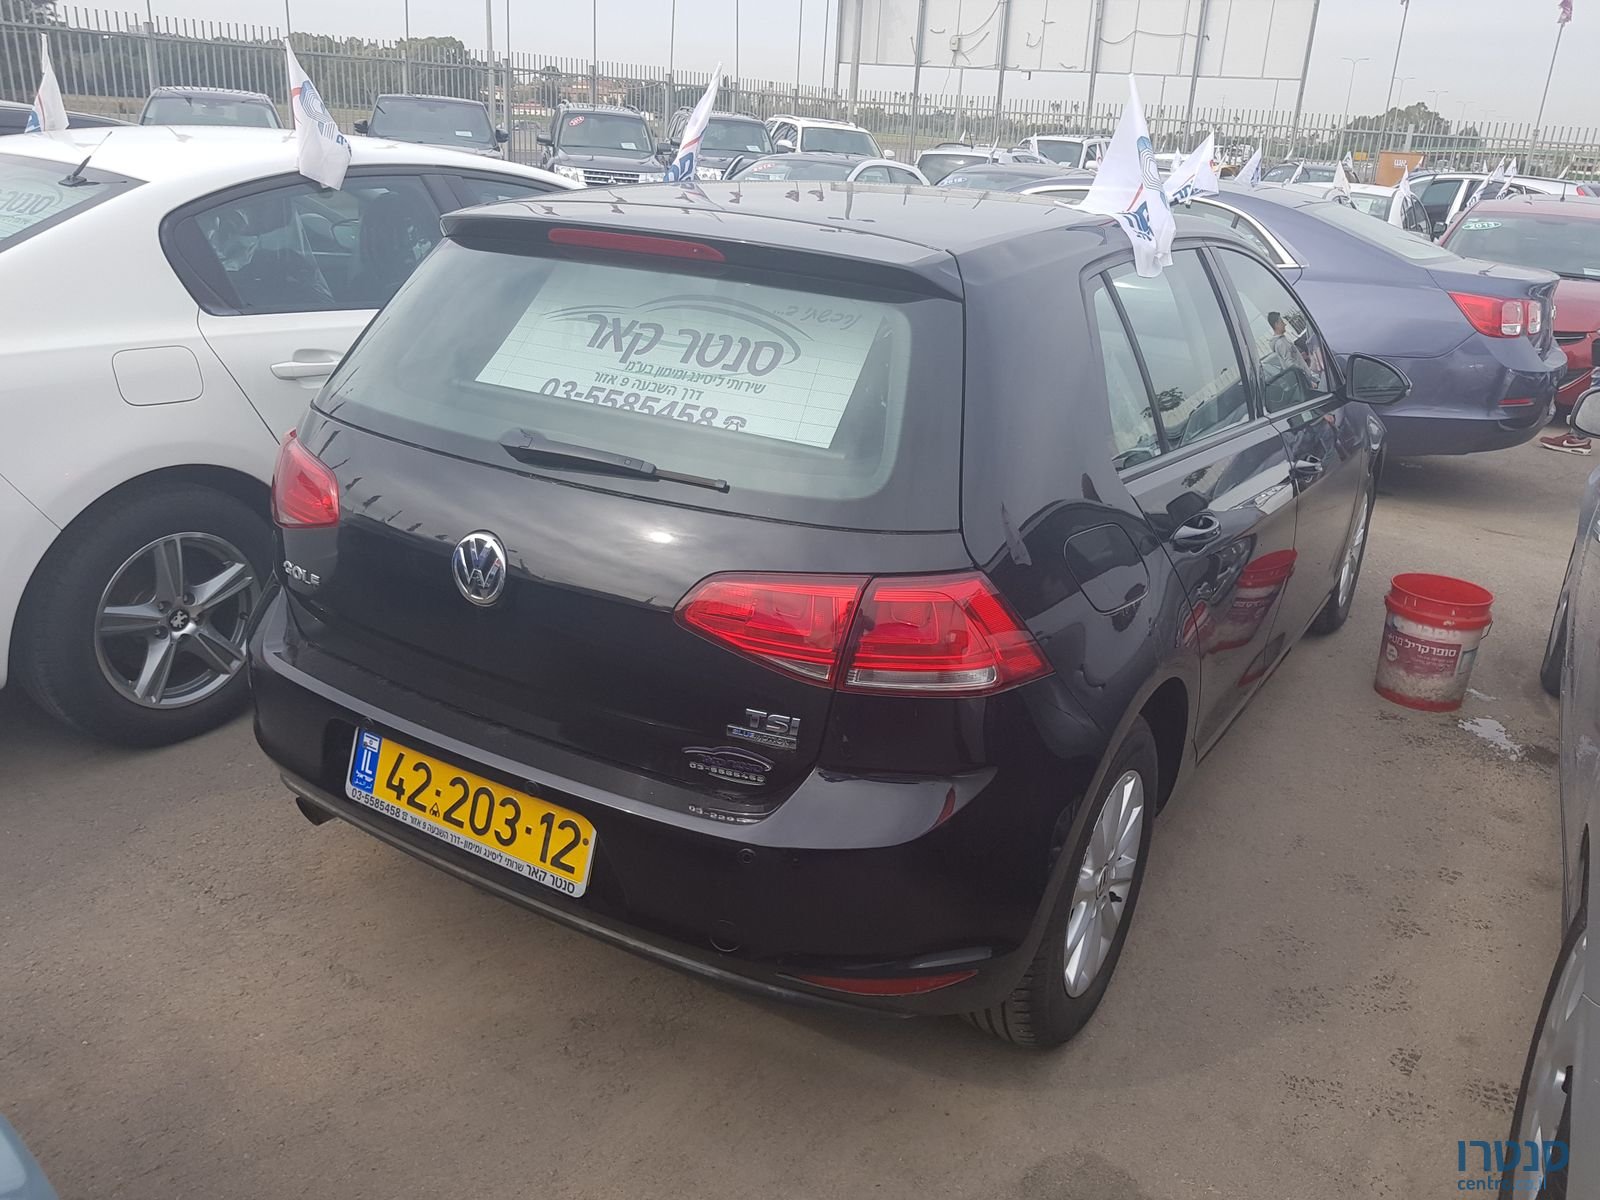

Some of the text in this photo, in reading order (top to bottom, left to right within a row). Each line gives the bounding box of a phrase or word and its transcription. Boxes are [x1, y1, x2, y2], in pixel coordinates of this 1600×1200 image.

[587, 313, 785, 377] סנטר קאר
[653, 366, 689, 382] ומימון
[689, 372, 726, 388] ליסינג
[593, 371, 704, 401] דרך השבעה 9 אזור
[726, 378, 767, 394] שירותי
[282, 560, 321, 587] GOLF
[745, 708, 801, 736] TSI
[361, 749, 373, 775] IL
[351, 788, 402, 818] 03-5585458
[409, 815, 421, 827] אזור
[427, 823, 449, 839] השבעה
[483, 848, 503, 864] ליסינג
[526, 864, 547, 882] קאר
[550, 874, 575, 894] סנטר
